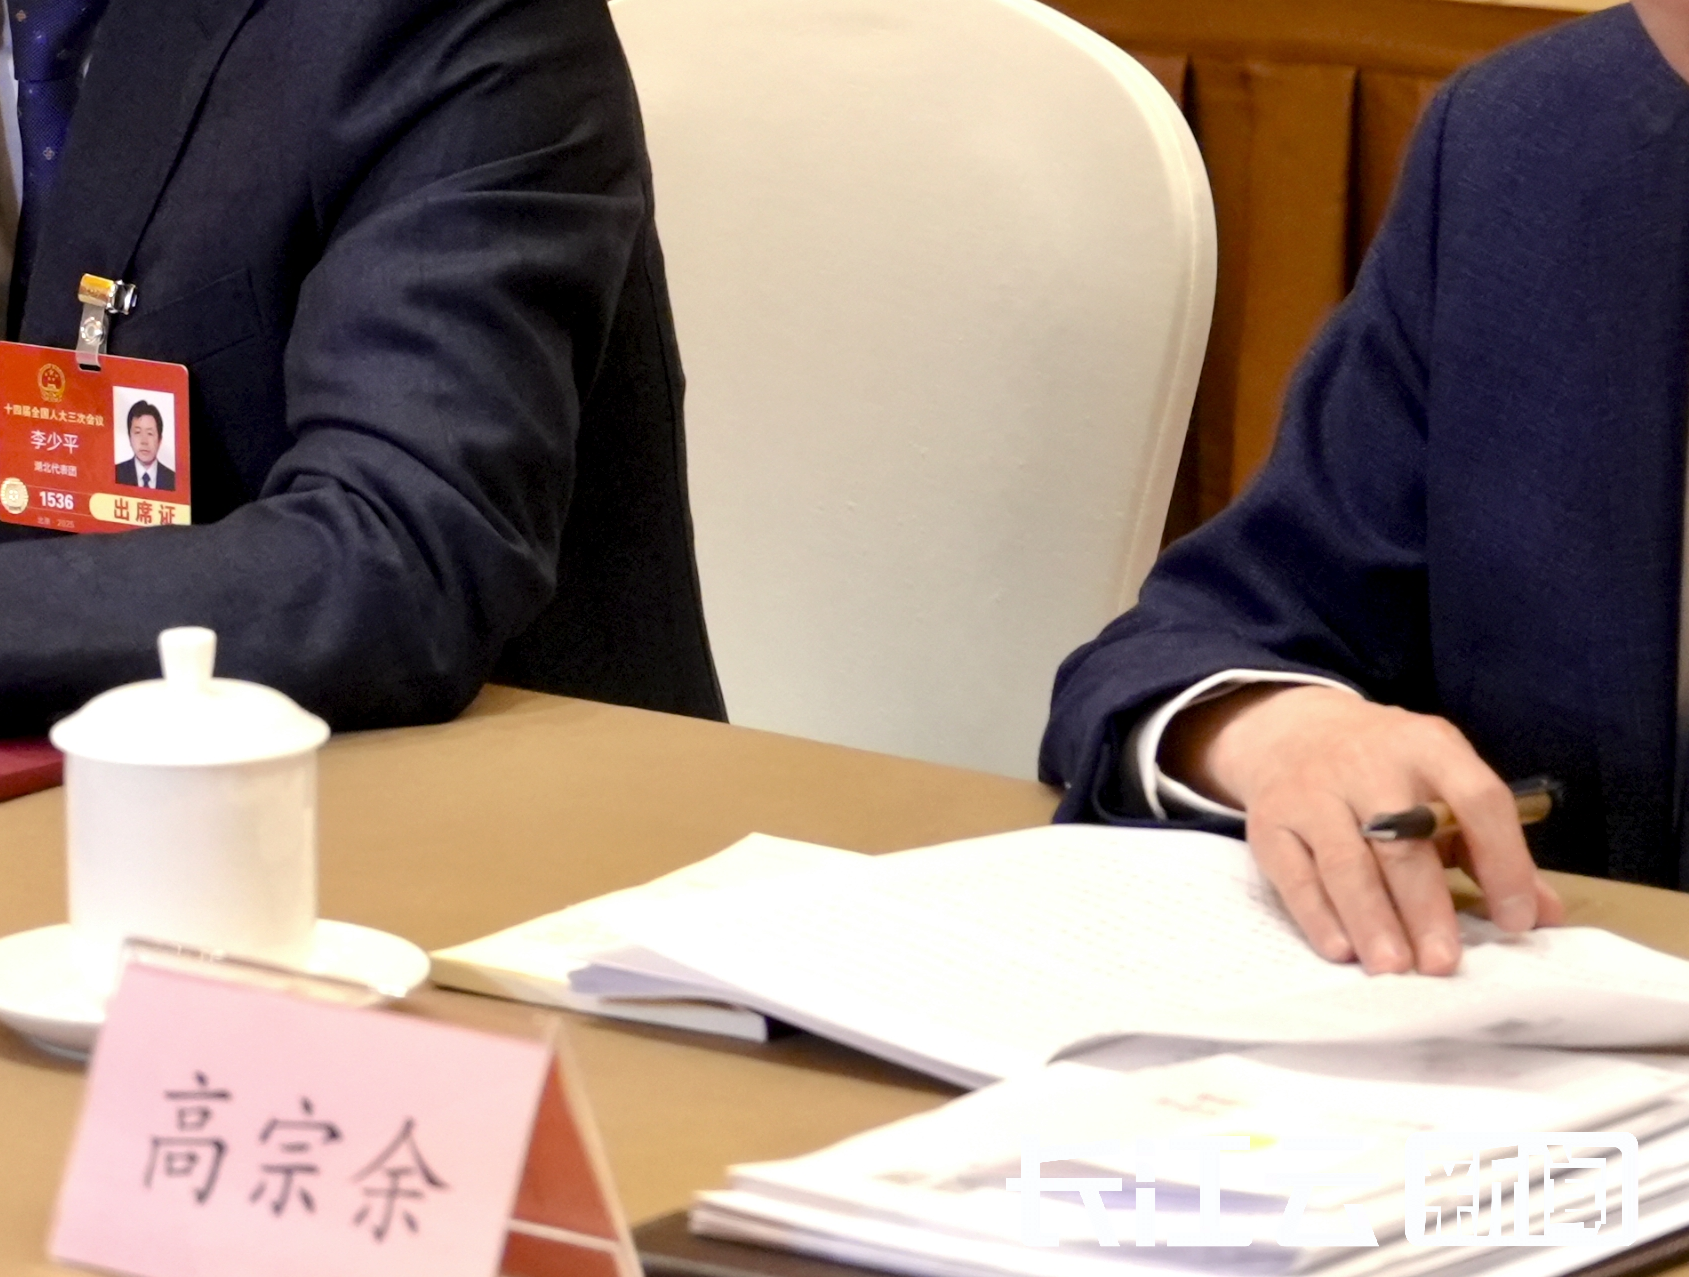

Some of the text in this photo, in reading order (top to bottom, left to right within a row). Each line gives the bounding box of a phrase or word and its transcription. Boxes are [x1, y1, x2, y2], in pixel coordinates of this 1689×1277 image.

[4, 403, 104, 427] 十四届全国人大三次会议
[30, 430, 79, 454] 李少平
[34, 461, 77, 477] 湖北代表团
[39, 491, 74, 510] 1536
[114, 498, 176, 525] 出席证
[142, 1069, 453, 1242] 高宗余
